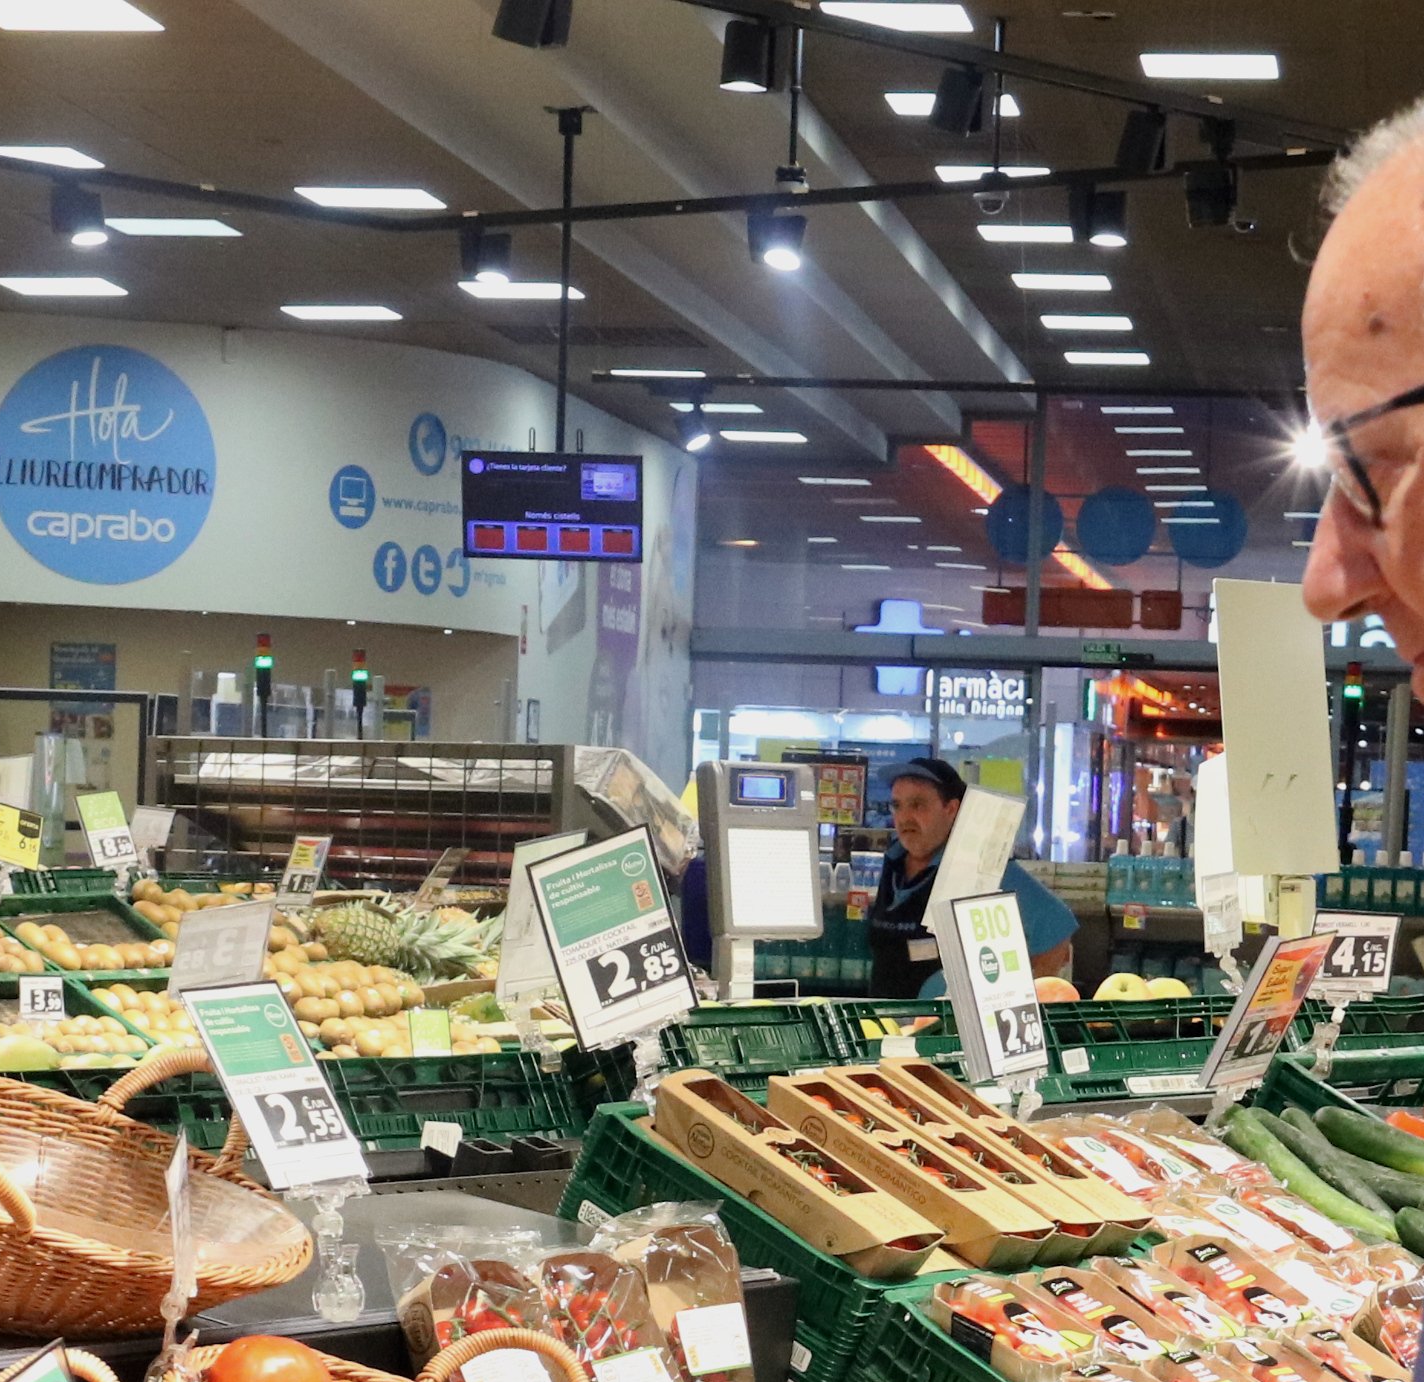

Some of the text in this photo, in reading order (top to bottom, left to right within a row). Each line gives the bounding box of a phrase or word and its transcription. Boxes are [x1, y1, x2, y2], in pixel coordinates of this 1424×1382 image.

[20, 356, 174, 465] Hola
[27, 509, 176, 545] caprabo
[546, 876, 571, 893] Fruita
[969, 904, 1011, 942] BIO
[597, 947, 681, 999] 2,85
[1331, 936, 1387, 978] 4,15
[999, 1007, 1042, 1053] 2,49
[264, 1092, 343, 1144] 2,55
